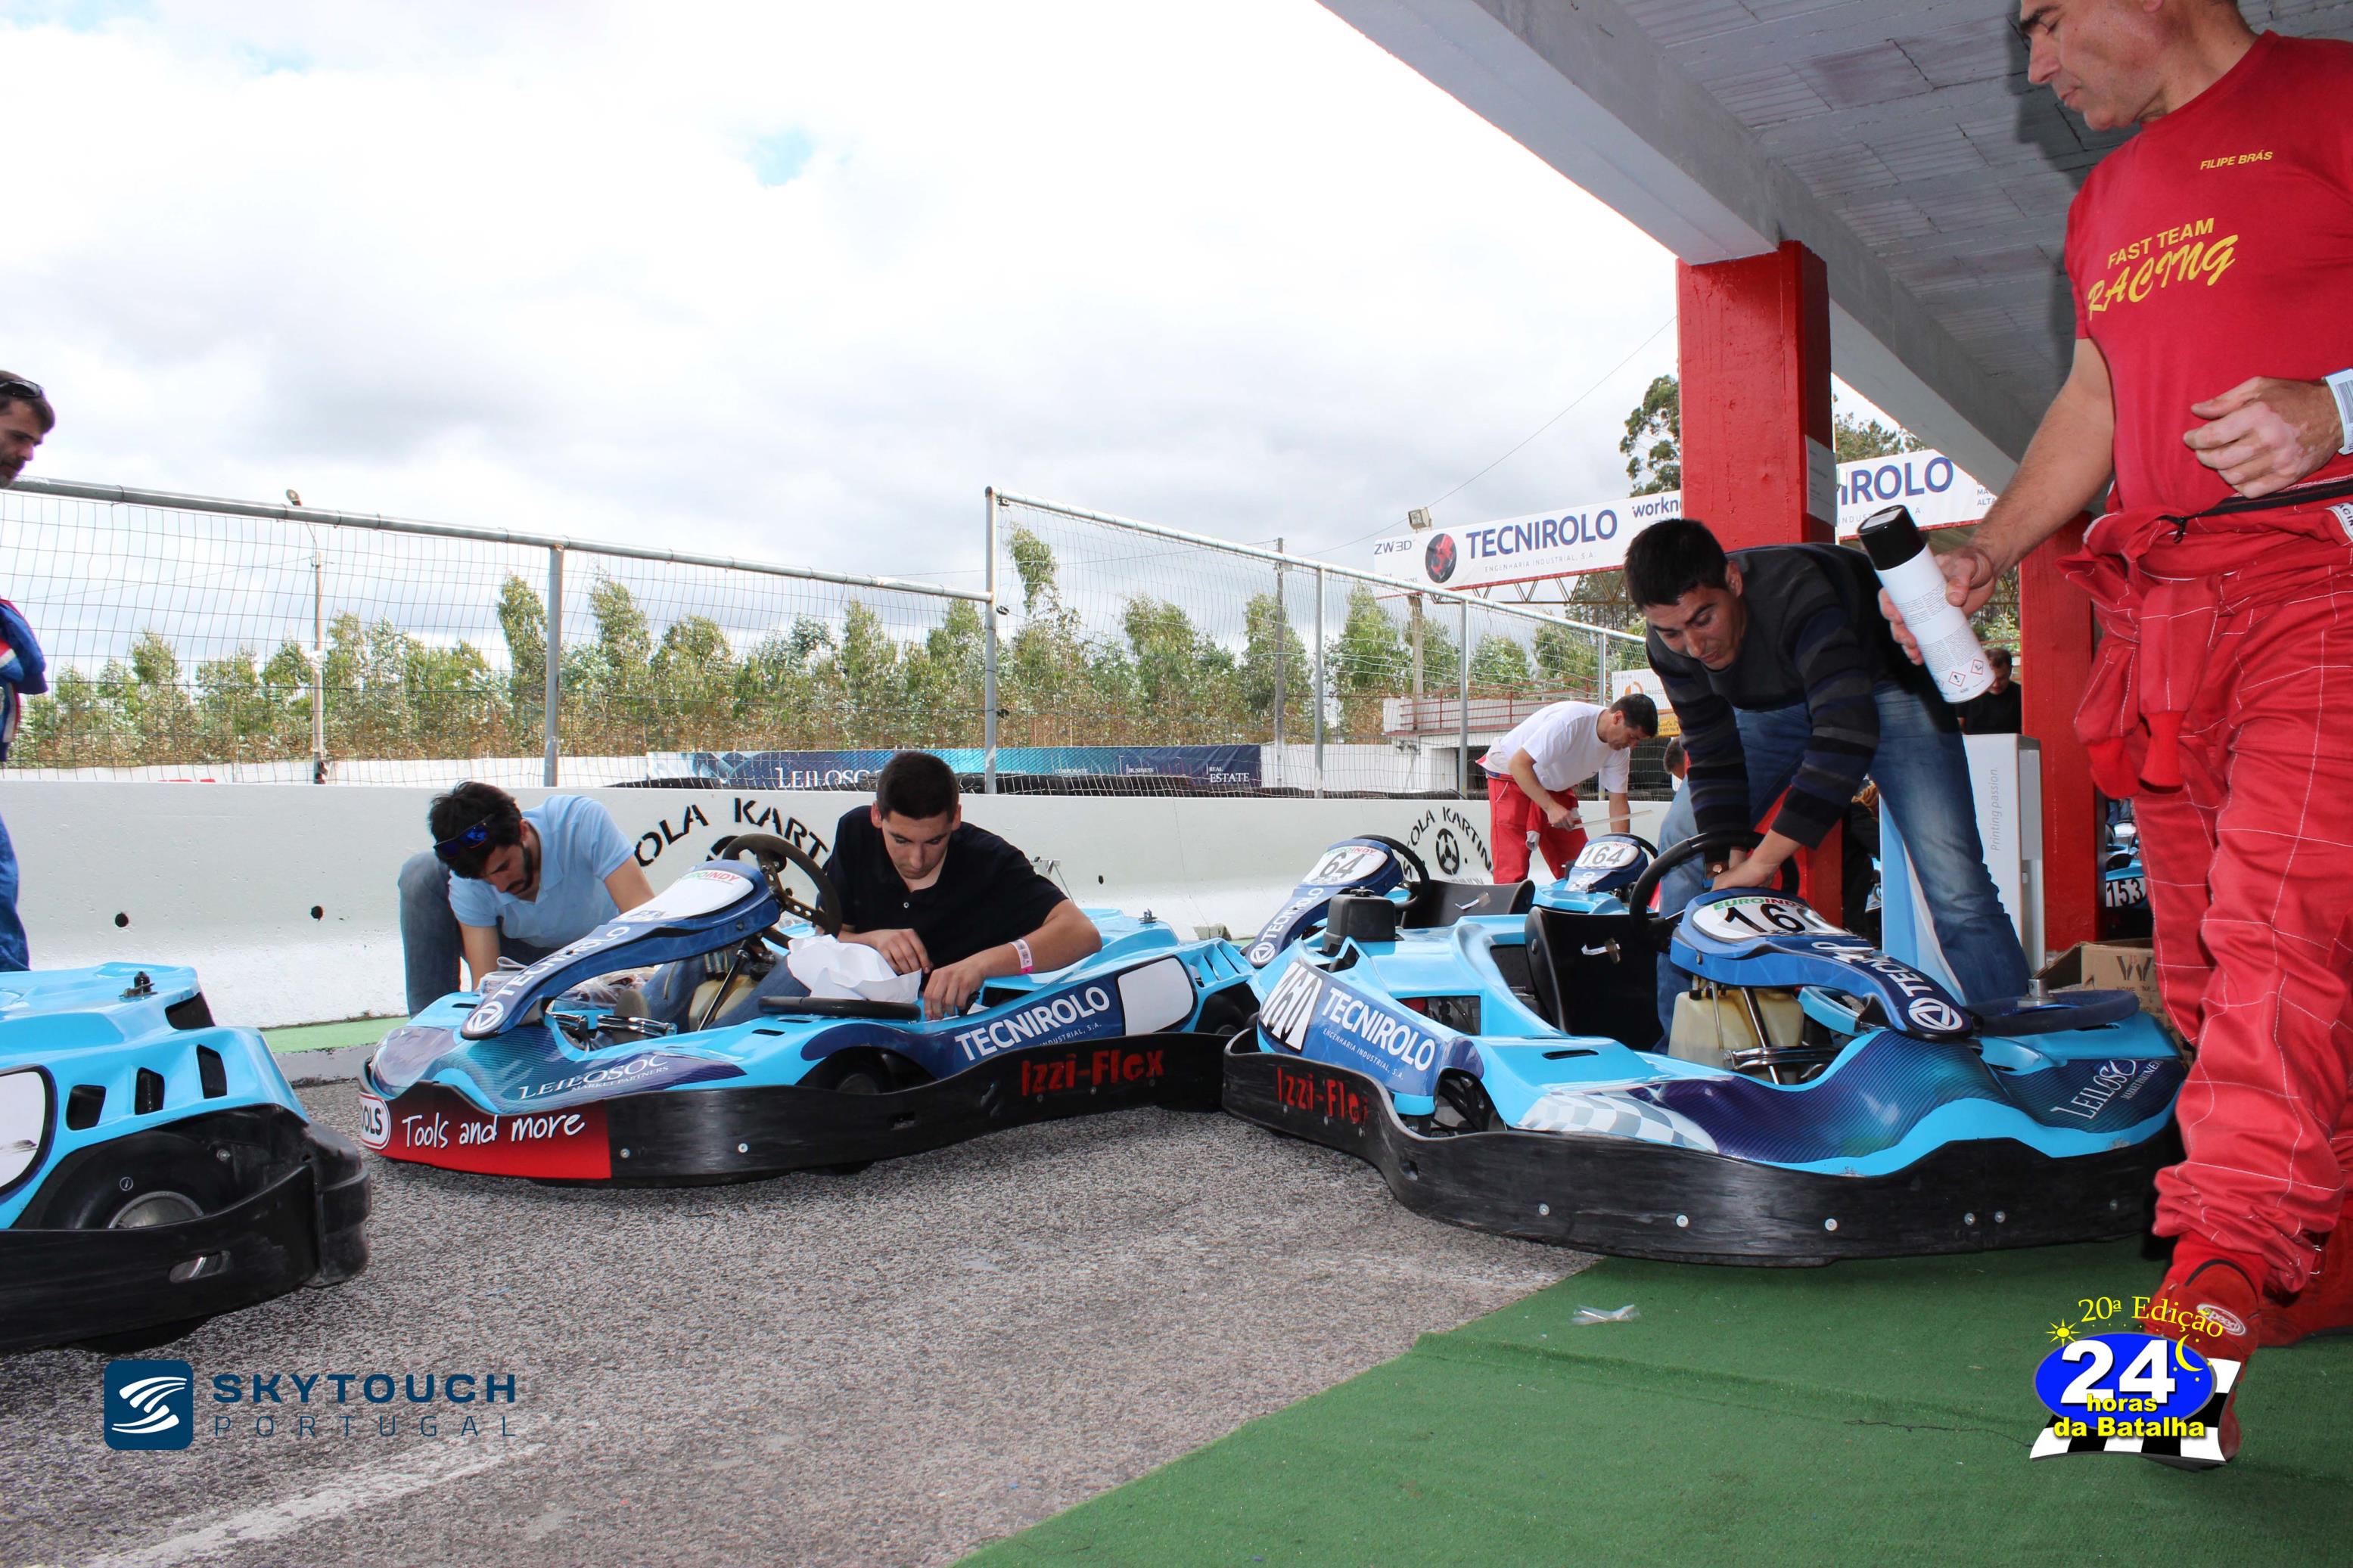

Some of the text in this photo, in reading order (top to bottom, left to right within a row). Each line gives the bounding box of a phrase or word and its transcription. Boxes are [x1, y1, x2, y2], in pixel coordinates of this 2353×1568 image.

[2200, 150, 2274, 170] FILIPE BRÁS
[2107, 218, 2215, 269] FAST TEAM
[2087, 234, 2239, 321] RACING
[1841, 456, 1954, 505] IROLO
[1632, 496, 1681, 518] workn
[1466, 508, 1618, 560] TECNIROLO
[1484, 560, 1531, 573] ENGENHARIA
[1210, 772, 1250, 784] ESTATE
[634, 797, 829, 867] OLA KART
[1442, 806, 1494, 875] KARTIN
[1990, 809, 2003, 851] Printing
[1319, 852, 1366, 880] 64
[1581, 846, 1625, 865] 164
[2106, 878, 2142, 907] 153
[954, 986, 1111, 1062] TECNIROLO
[1322, 986, 1436, 1072] TECNIROLO
[1323, 1028, 1357, 1052] ENGENHARIA
[518, 1054, 669, 1101] LEILOSOC
[571, 1065, 670, 1092] MARKET PARTNERS
[362, 1105, 384, 1137] OLS
[402, 1112, 586, 1148] Tools and more
